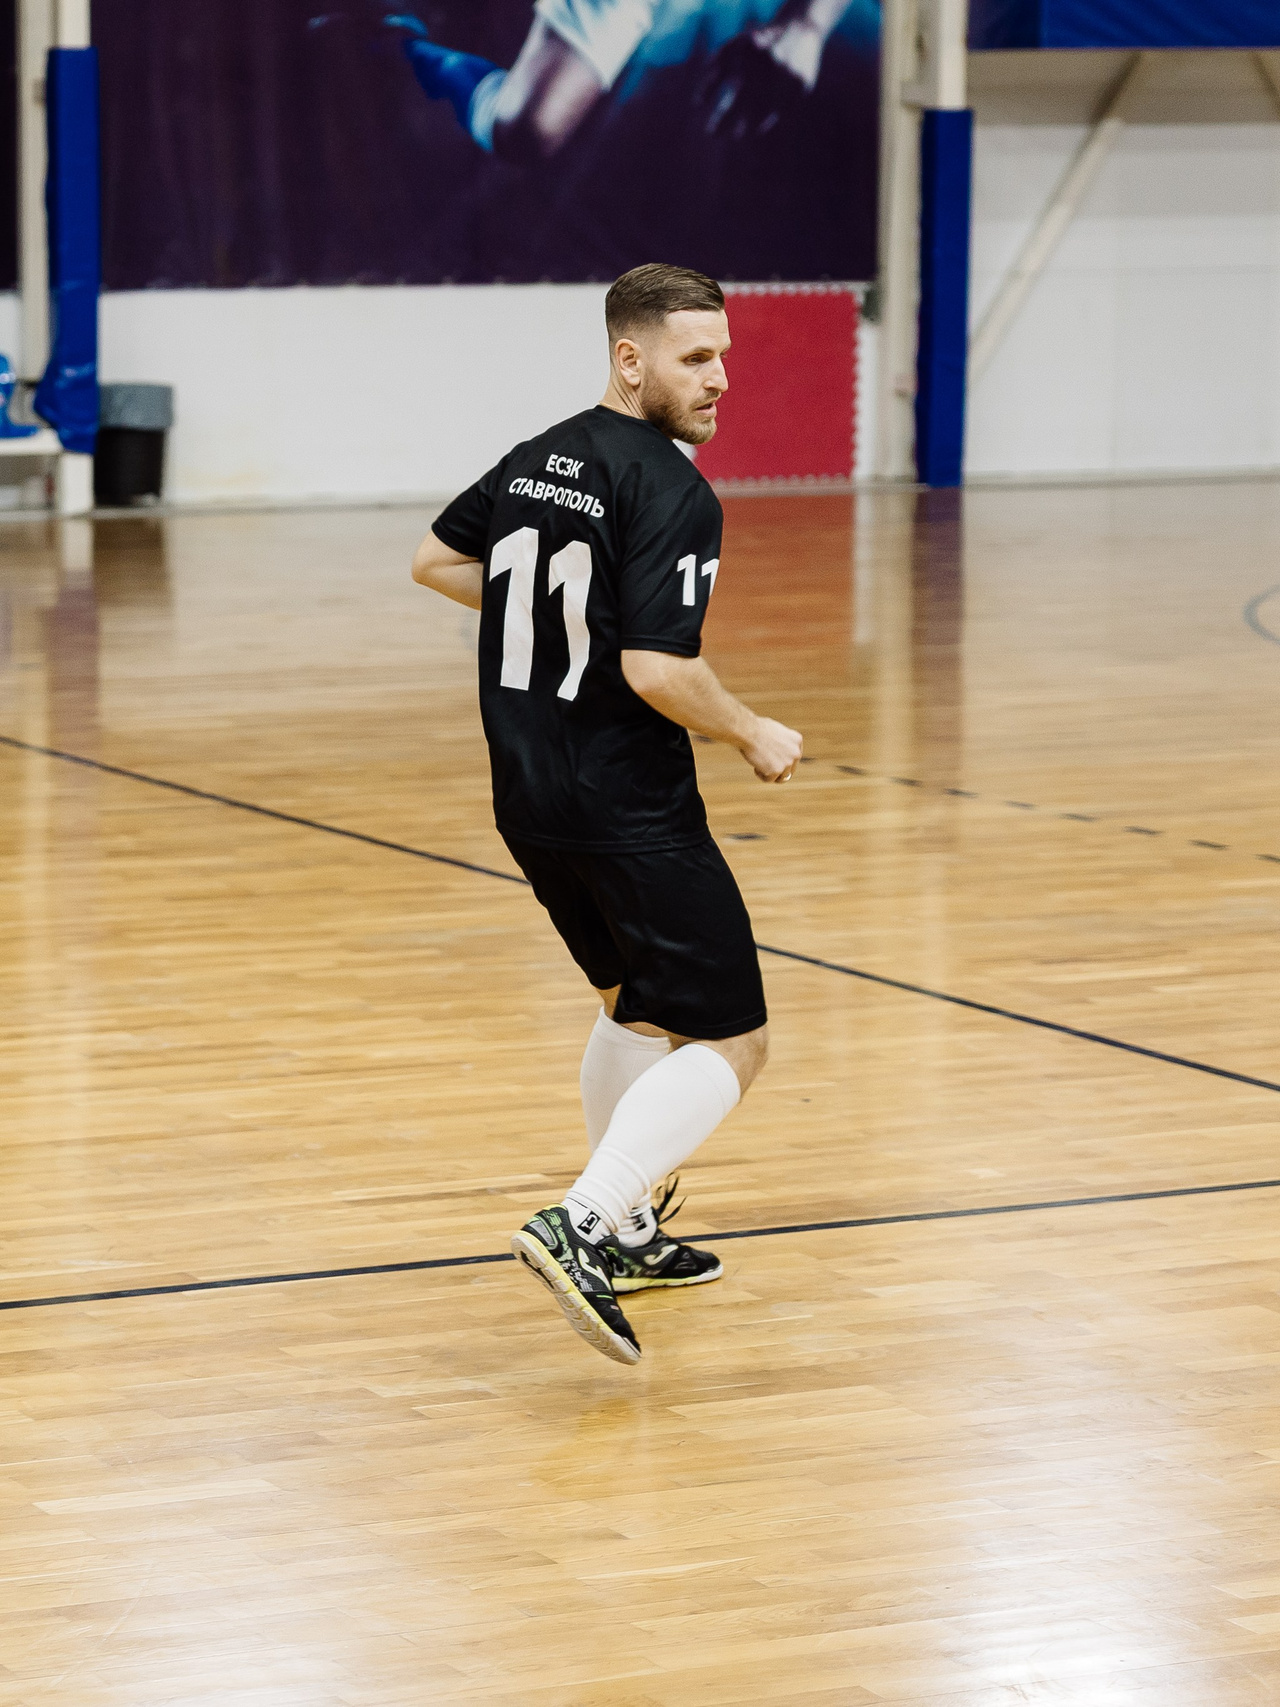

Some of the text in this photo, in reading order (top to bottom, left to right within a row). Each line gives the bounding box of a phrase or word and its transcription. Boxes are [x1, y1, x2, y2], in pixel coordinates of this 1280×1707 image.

[545, 453, 584, 479] ЕСЗК
[508, 477, 605, 518] СТАВРОПОЛЬ
[676, 554, 720, 606] 11
[489, 526, 593, 702] 11
